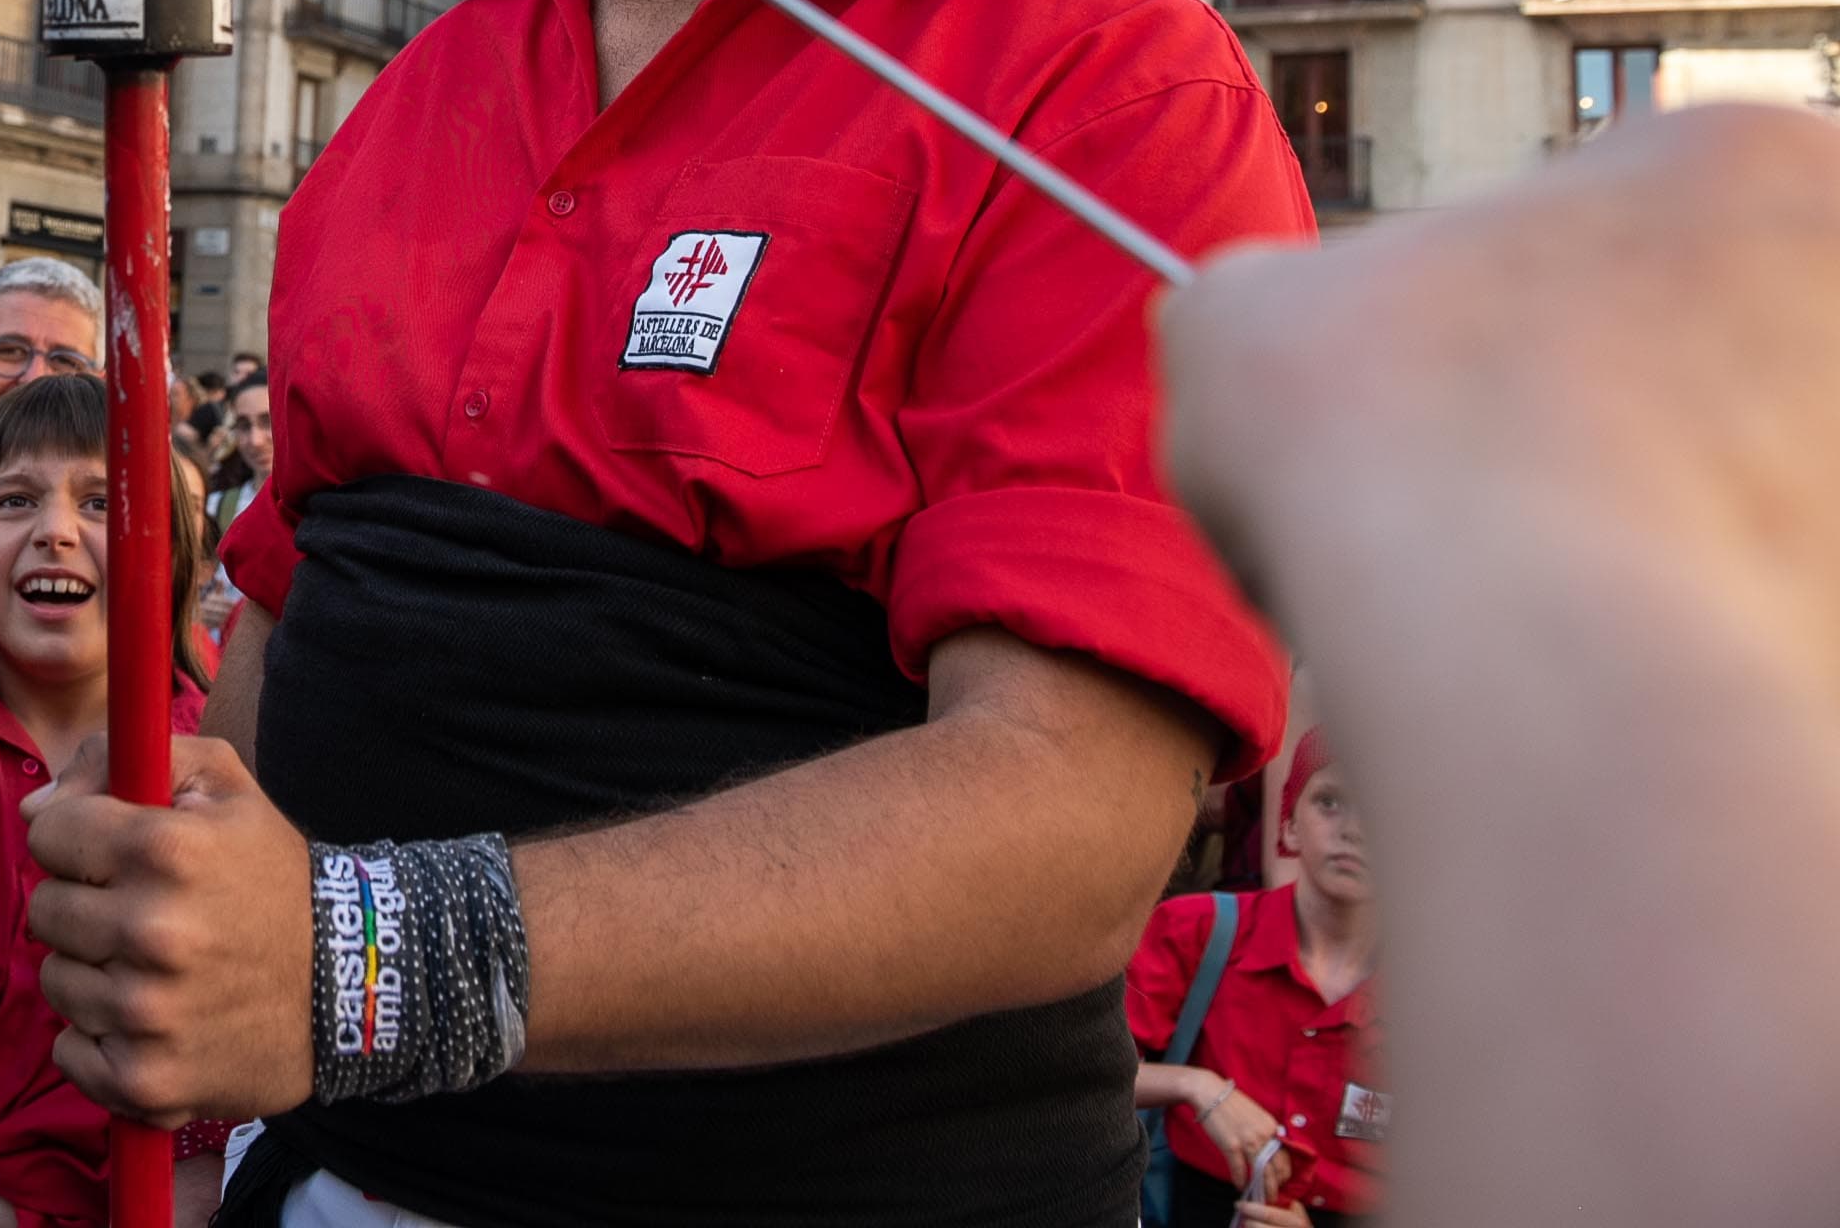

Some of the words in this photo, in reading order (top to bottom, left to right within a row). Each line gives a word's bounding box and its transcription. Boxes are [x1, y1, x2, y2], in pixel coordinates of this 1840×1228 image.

[633, 317, 700, 335] CASTELLERS
[699, 321, 722, 340] DE
[638, 334, 695, 354] BARCELONA
[366, 857, 406, 955] orgull
[316, 854, 364, 1055] castells
[372, 967, 402, 1052] amb
